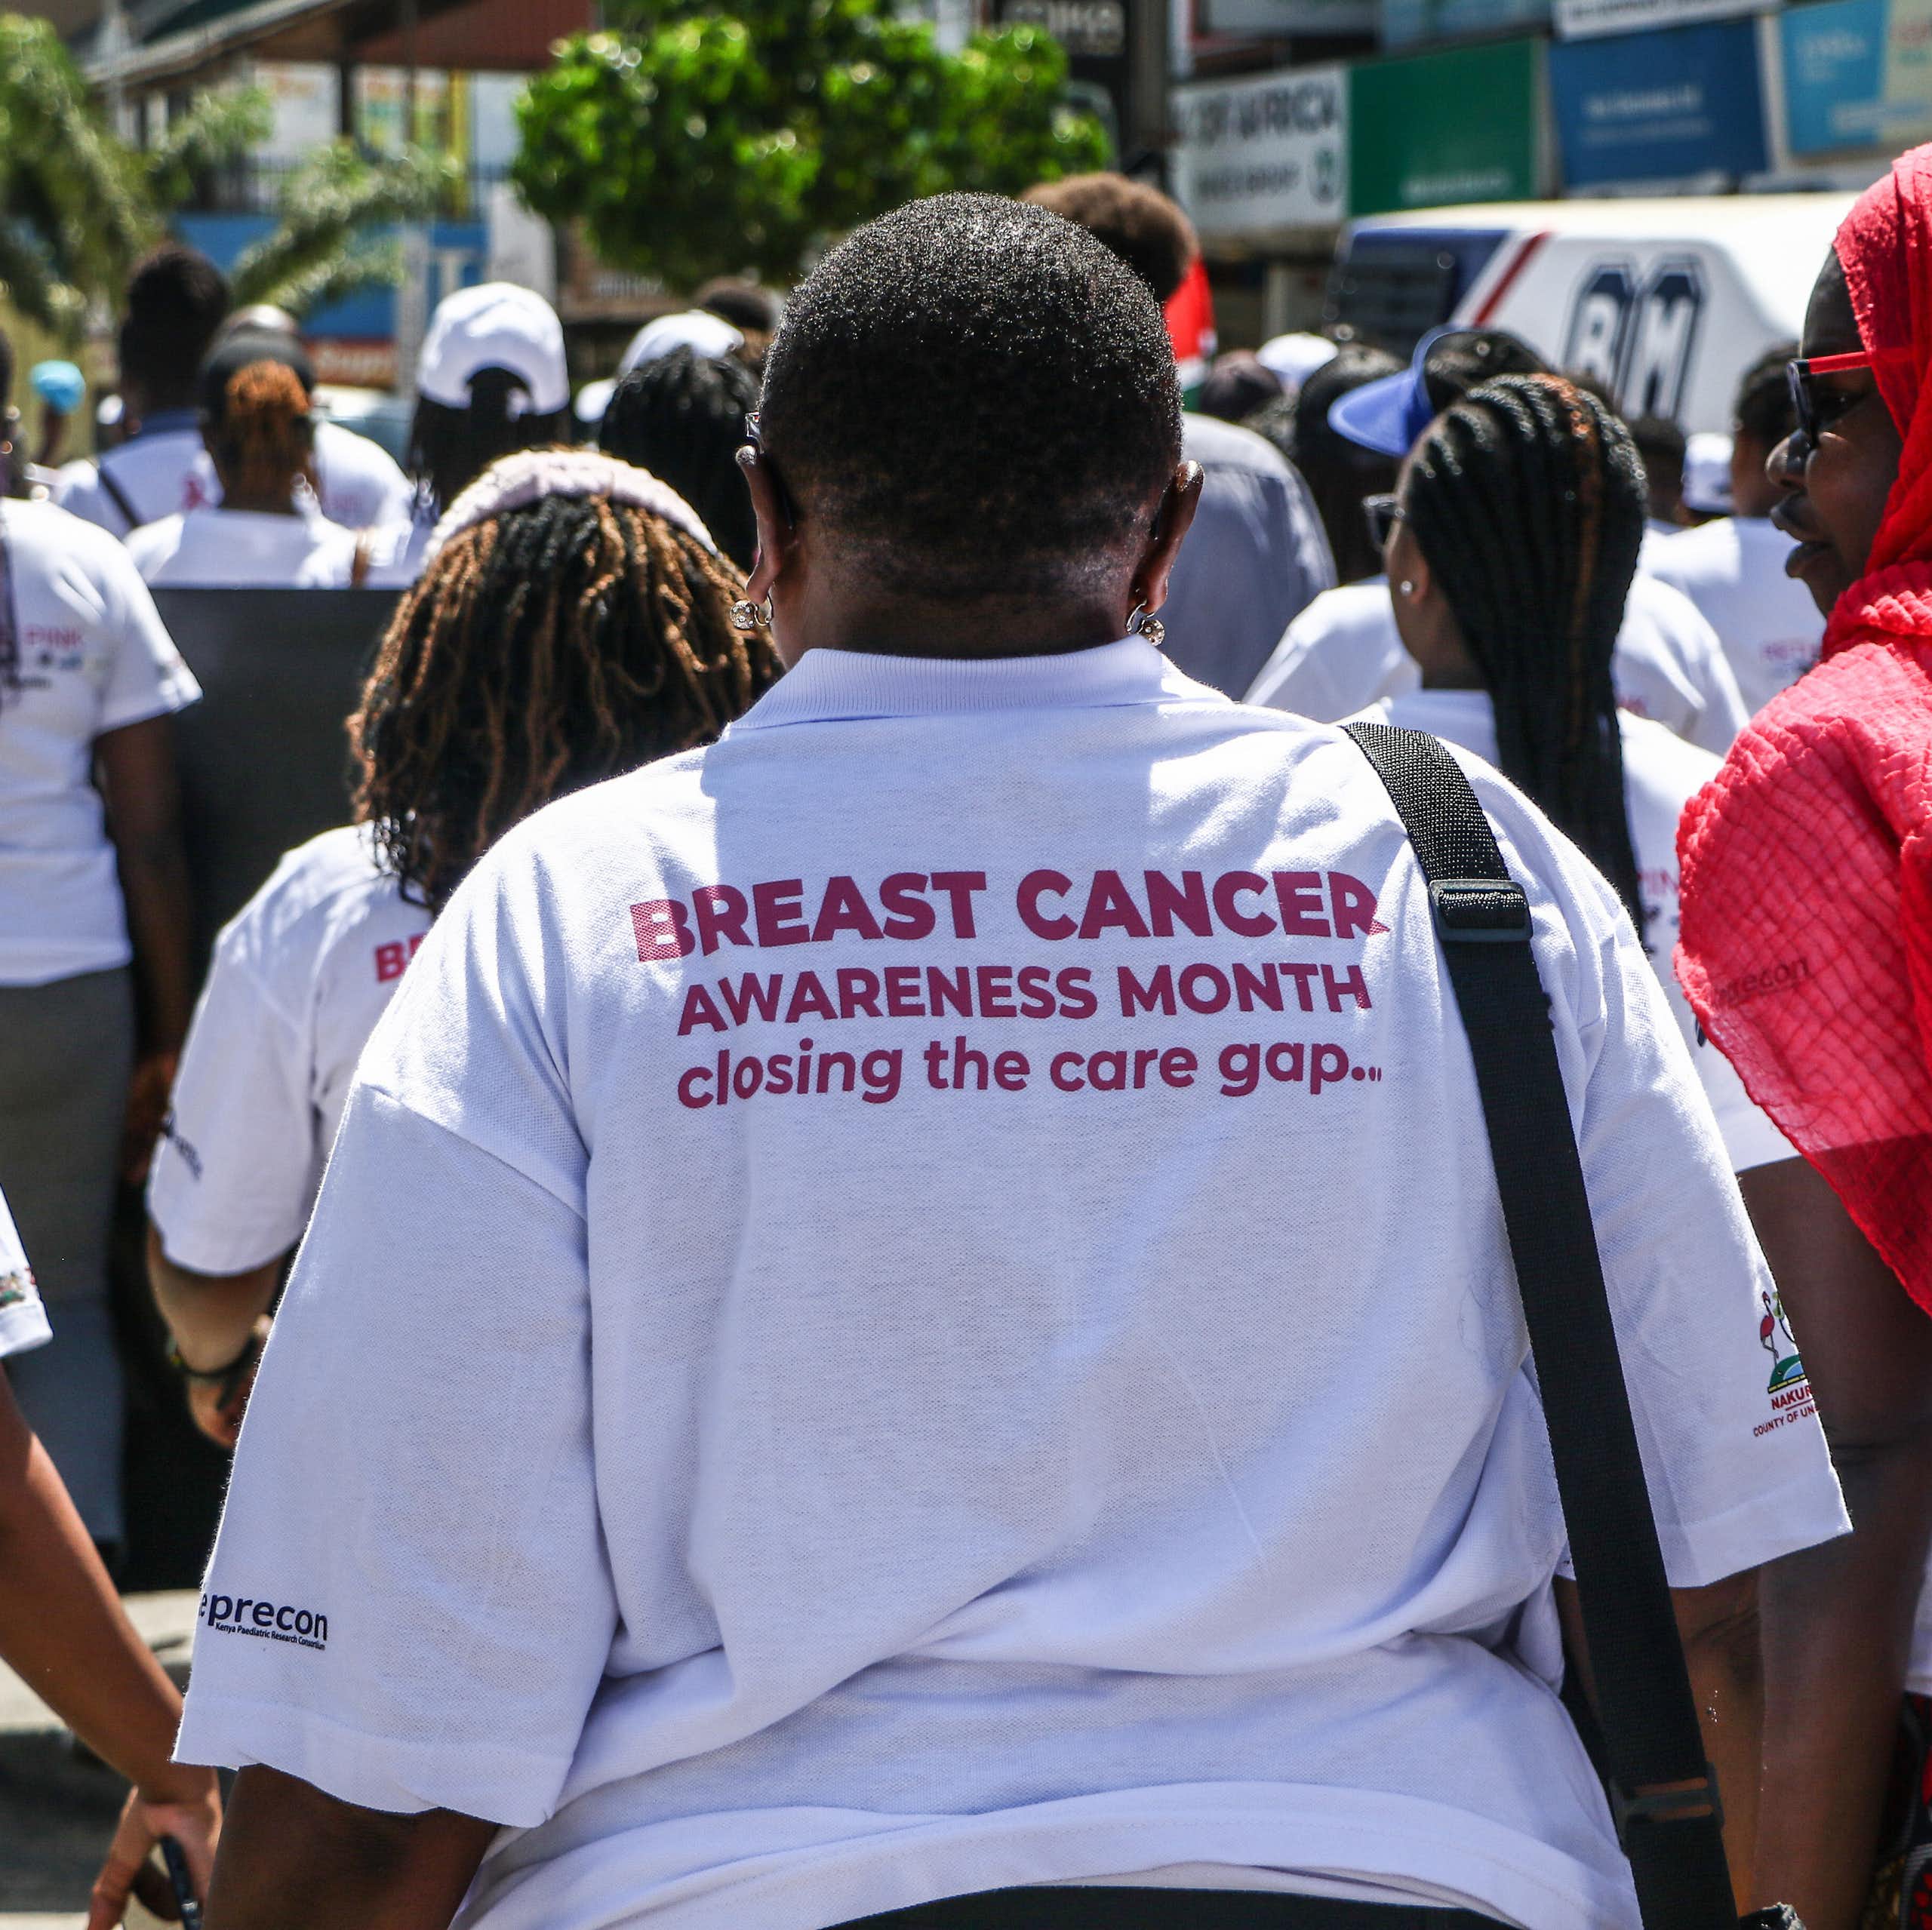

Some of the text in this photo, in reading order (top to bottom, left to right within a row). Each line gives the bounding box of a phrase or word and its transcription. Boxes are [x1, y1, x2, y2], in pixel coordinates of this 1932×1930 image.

[629, 868, 1390, 962] BREAST CANCER
[677, 962, 1373, 1036] AWARENESS MONTH
[678, 1035, 1383, 1109] closing the care gap...
[1753, 1415, 1784, 1437] COUNTY
[1786, 1410, 1799, 1423] OF
[215, 1621, 326, 1651] Kenya Paediatric Research Consortium
